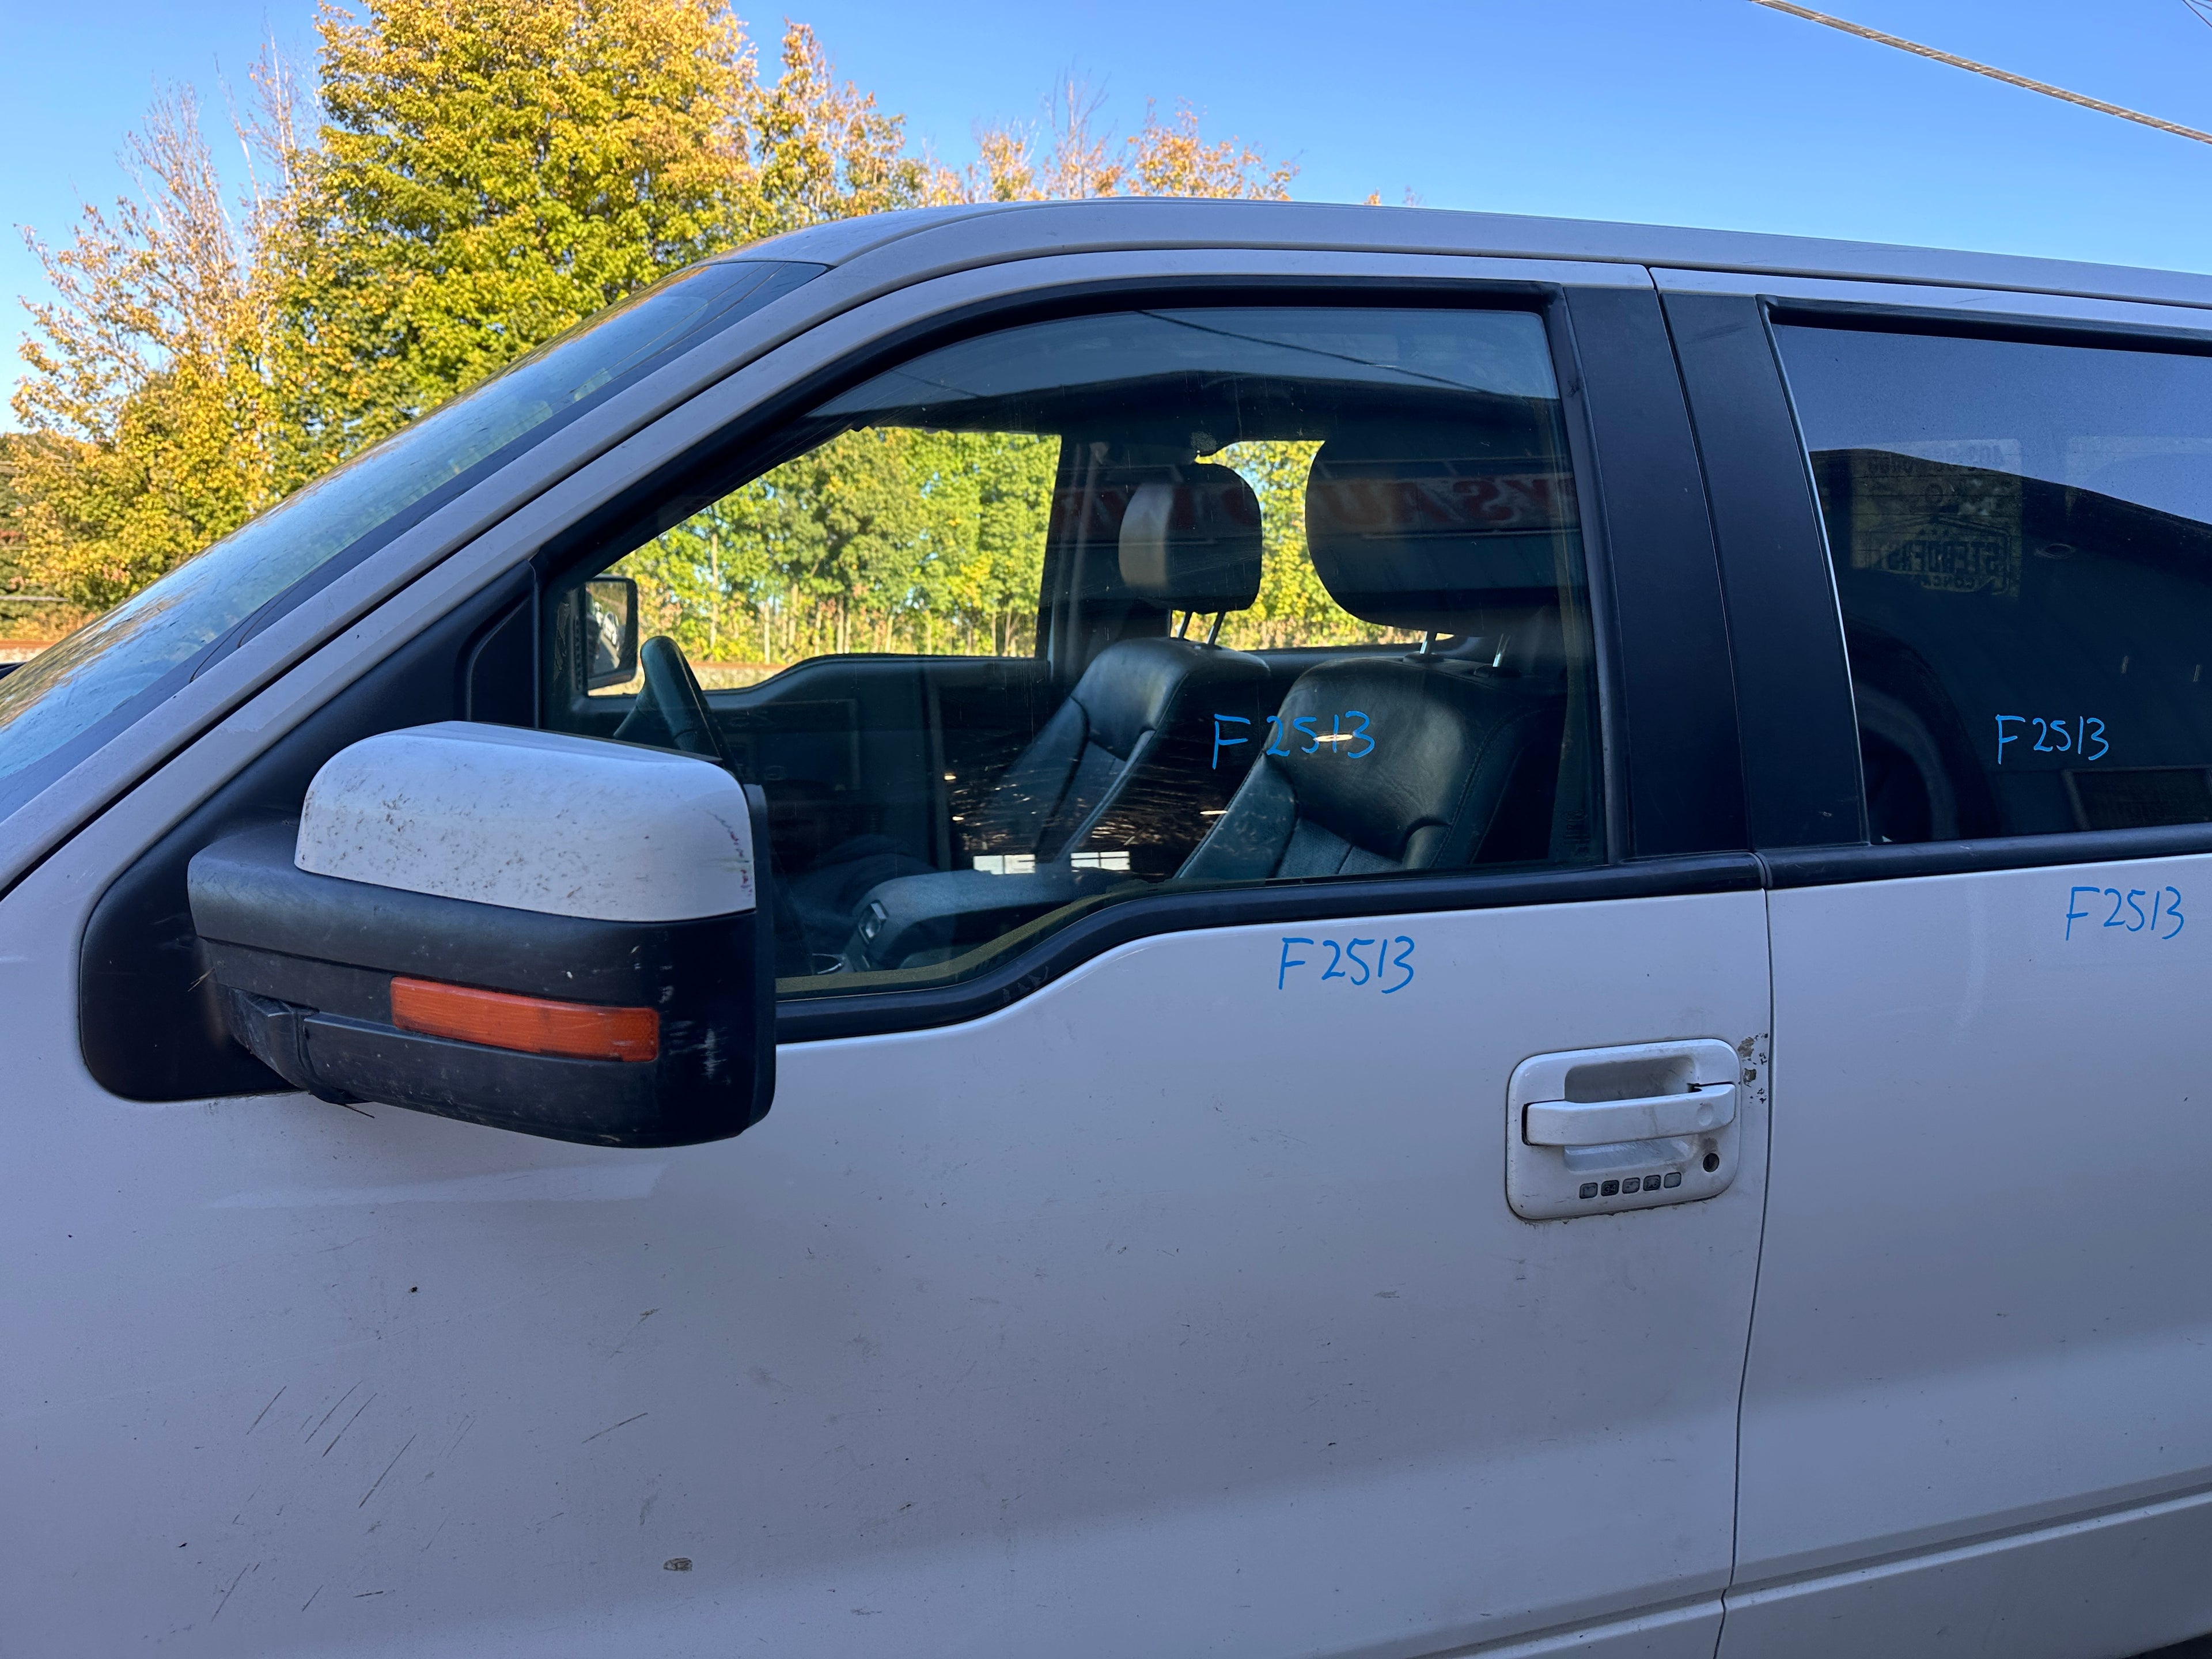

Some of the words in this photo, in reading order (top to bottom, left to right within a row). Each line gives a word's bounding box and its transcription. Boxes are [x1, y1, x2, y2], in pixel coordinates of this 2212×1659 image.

[1995, 714, 2109, 763] F2513
[2065, 885, 2185, 941] F2513
[1278, 934, 1415, 995] F2513
